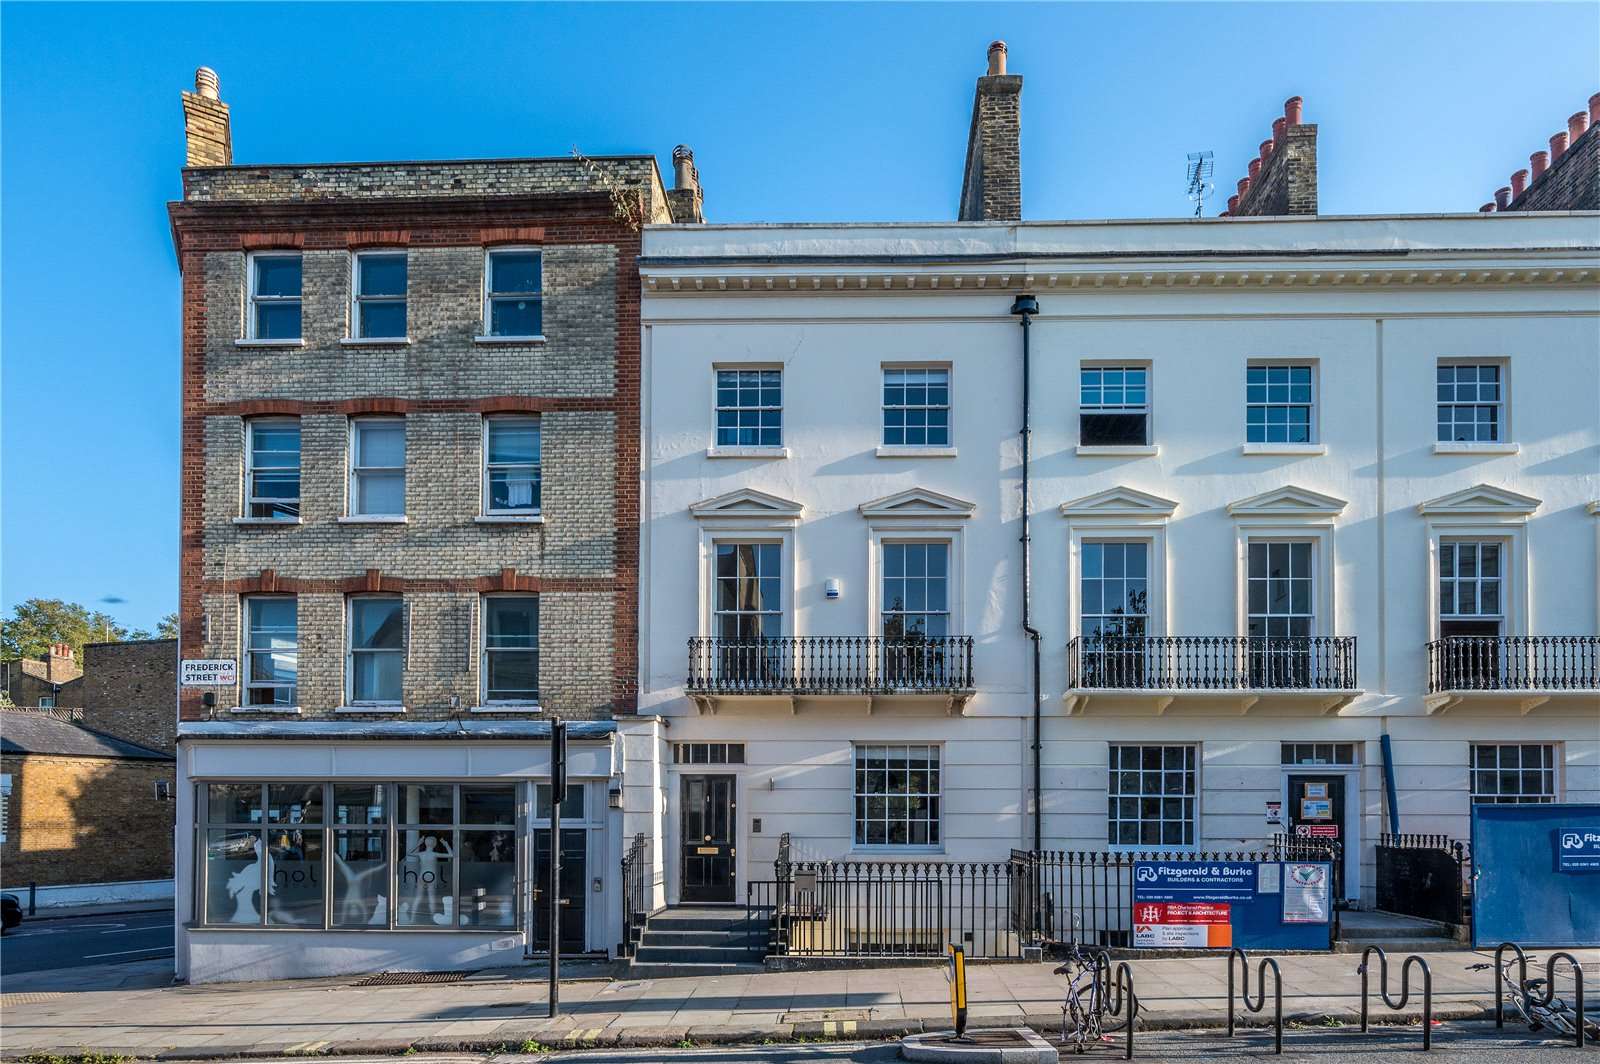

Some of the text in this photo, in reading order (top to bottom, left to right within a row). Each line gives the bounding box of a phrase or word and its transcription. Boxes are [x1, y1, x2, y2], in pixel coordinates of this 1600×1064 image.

[273, 863, 318, 882] hol
[403, 865, 447, 883] hol
[1158, 866, 1208, 877] Fitzgerald
[1211, 866, 1220, 876] &
[1223, 866, 1253, 876] Burke
